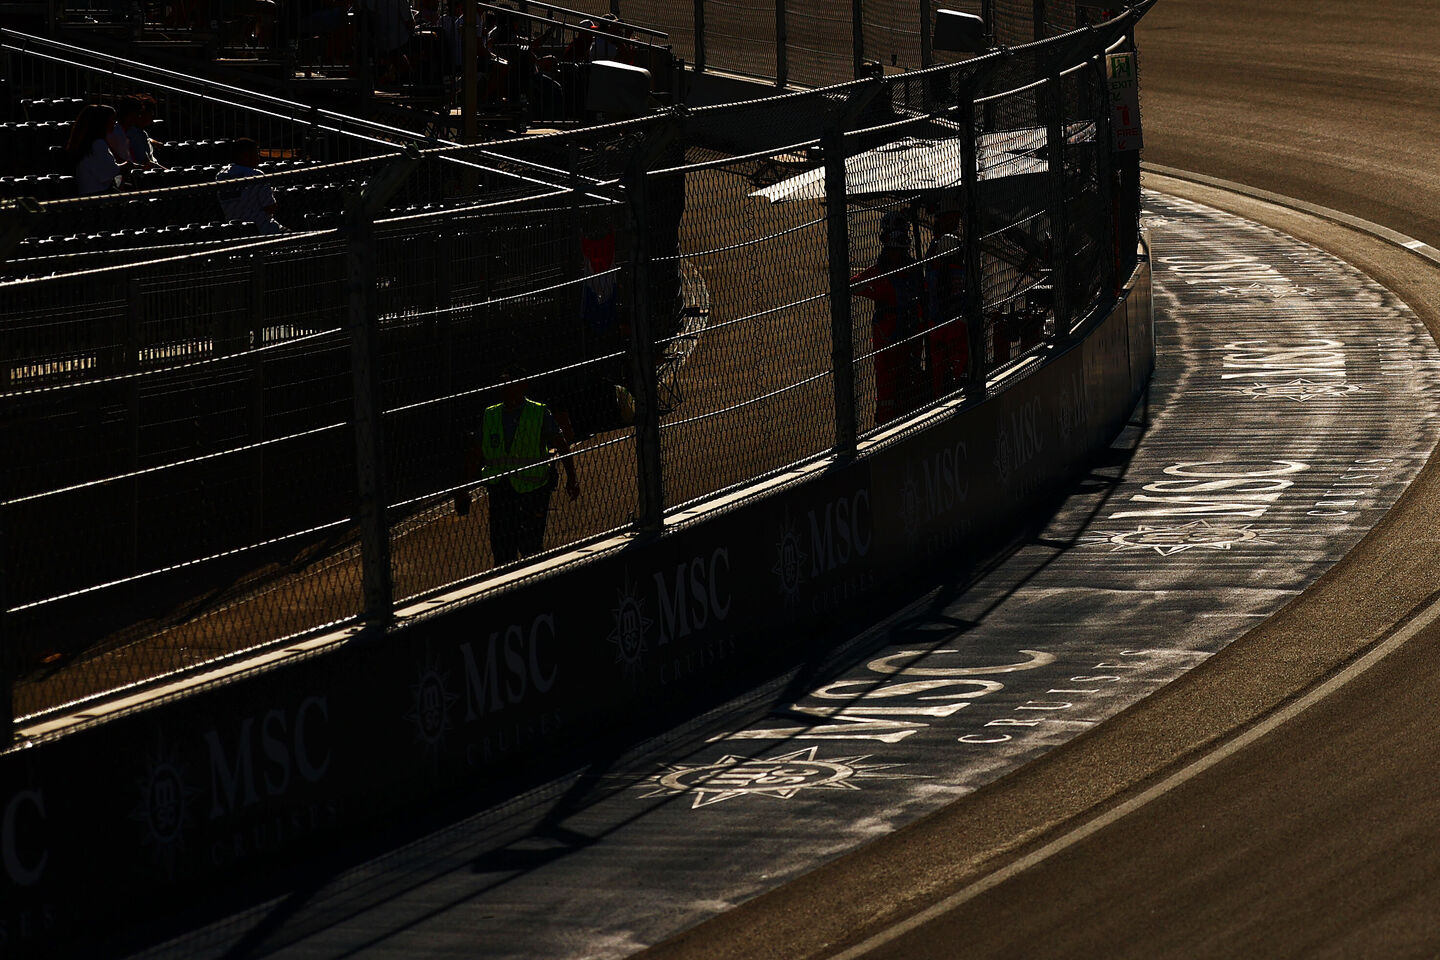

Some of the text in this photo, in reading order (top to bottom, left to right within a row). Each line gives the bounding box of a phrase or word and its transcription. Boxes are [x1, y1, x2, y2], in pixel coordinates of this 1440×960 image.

[1221, 339, 1347, 380] MSC
[921, 440, 969, 521] MSC
[1107, 460, 1312, 520] MSC
[807, 487, 872, 577] MSC
[652, 545, 732, 647] MSC
[459, 610, 560, 725] MSC
[705, 649, 1058, 744] MSC
[957, 648, 1153, 745] CRUISES
[202, 695, 333, 821] MSC
